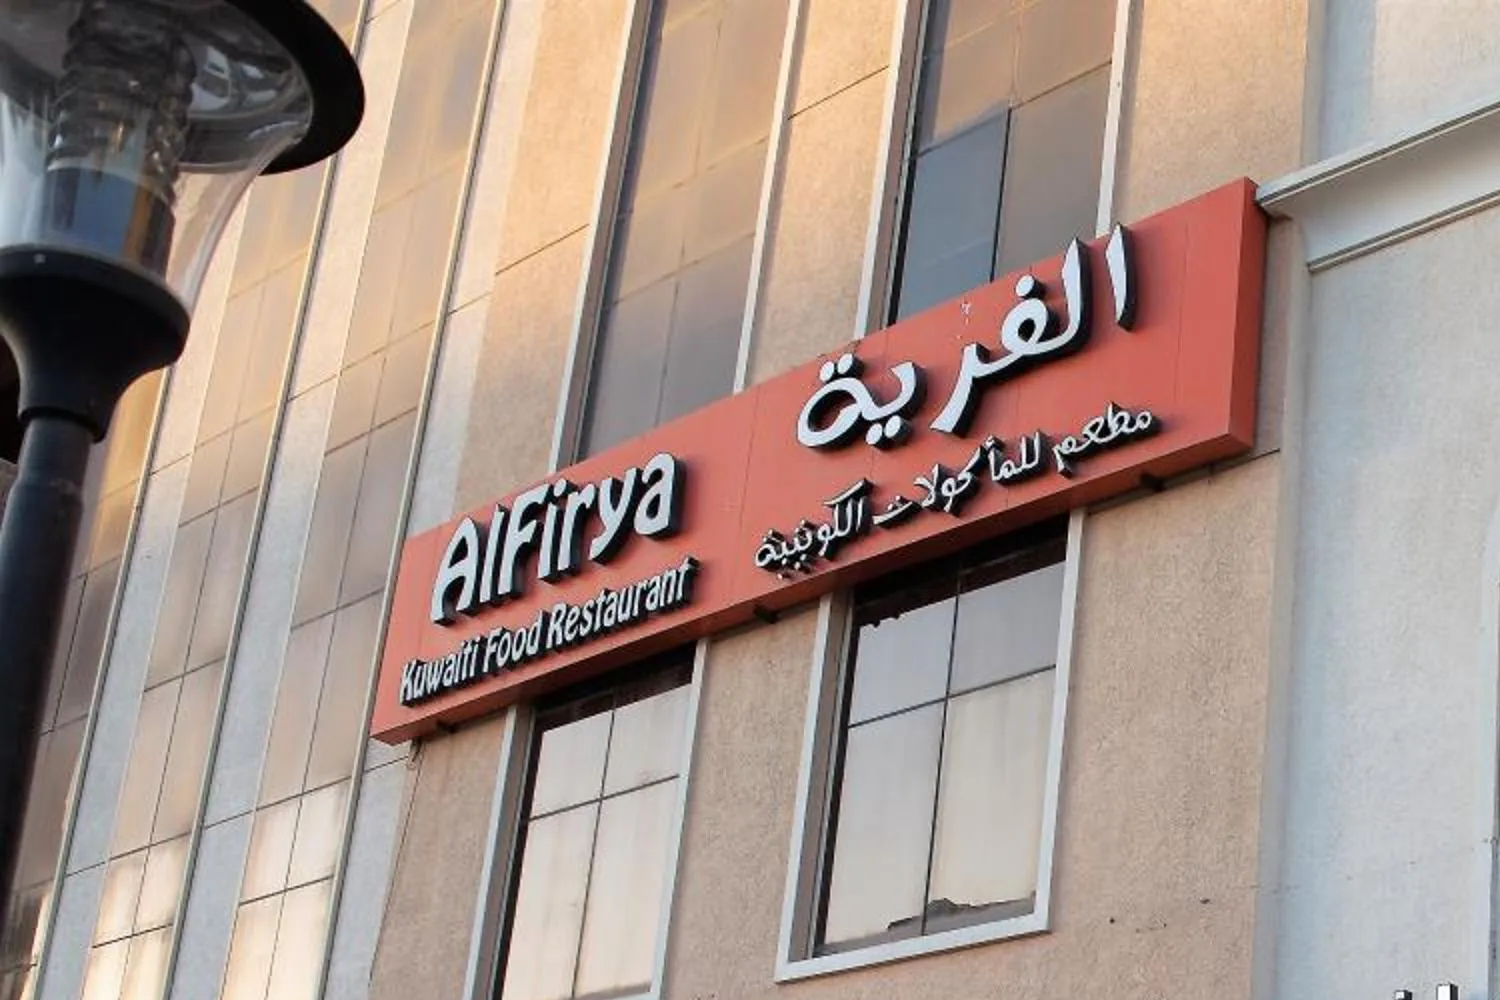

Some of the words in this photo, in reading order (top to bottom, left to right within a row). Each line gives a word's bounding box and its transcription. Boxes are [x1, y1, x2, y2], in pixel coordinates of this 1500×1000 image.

[796, 222, 1132, 448] الفرية
[872, 431, 1043, 526] للمأكولات
[1052, 402, 1156, 474] مطعم
[431, 453, 682, 625] AlFirya
[753, 479, 870, 579] الكويتية
[400, 638, 481, 706] Kuwaiti
[483, 611, 544, 675] Food
[546, 556, 698, 651] Restaurant
